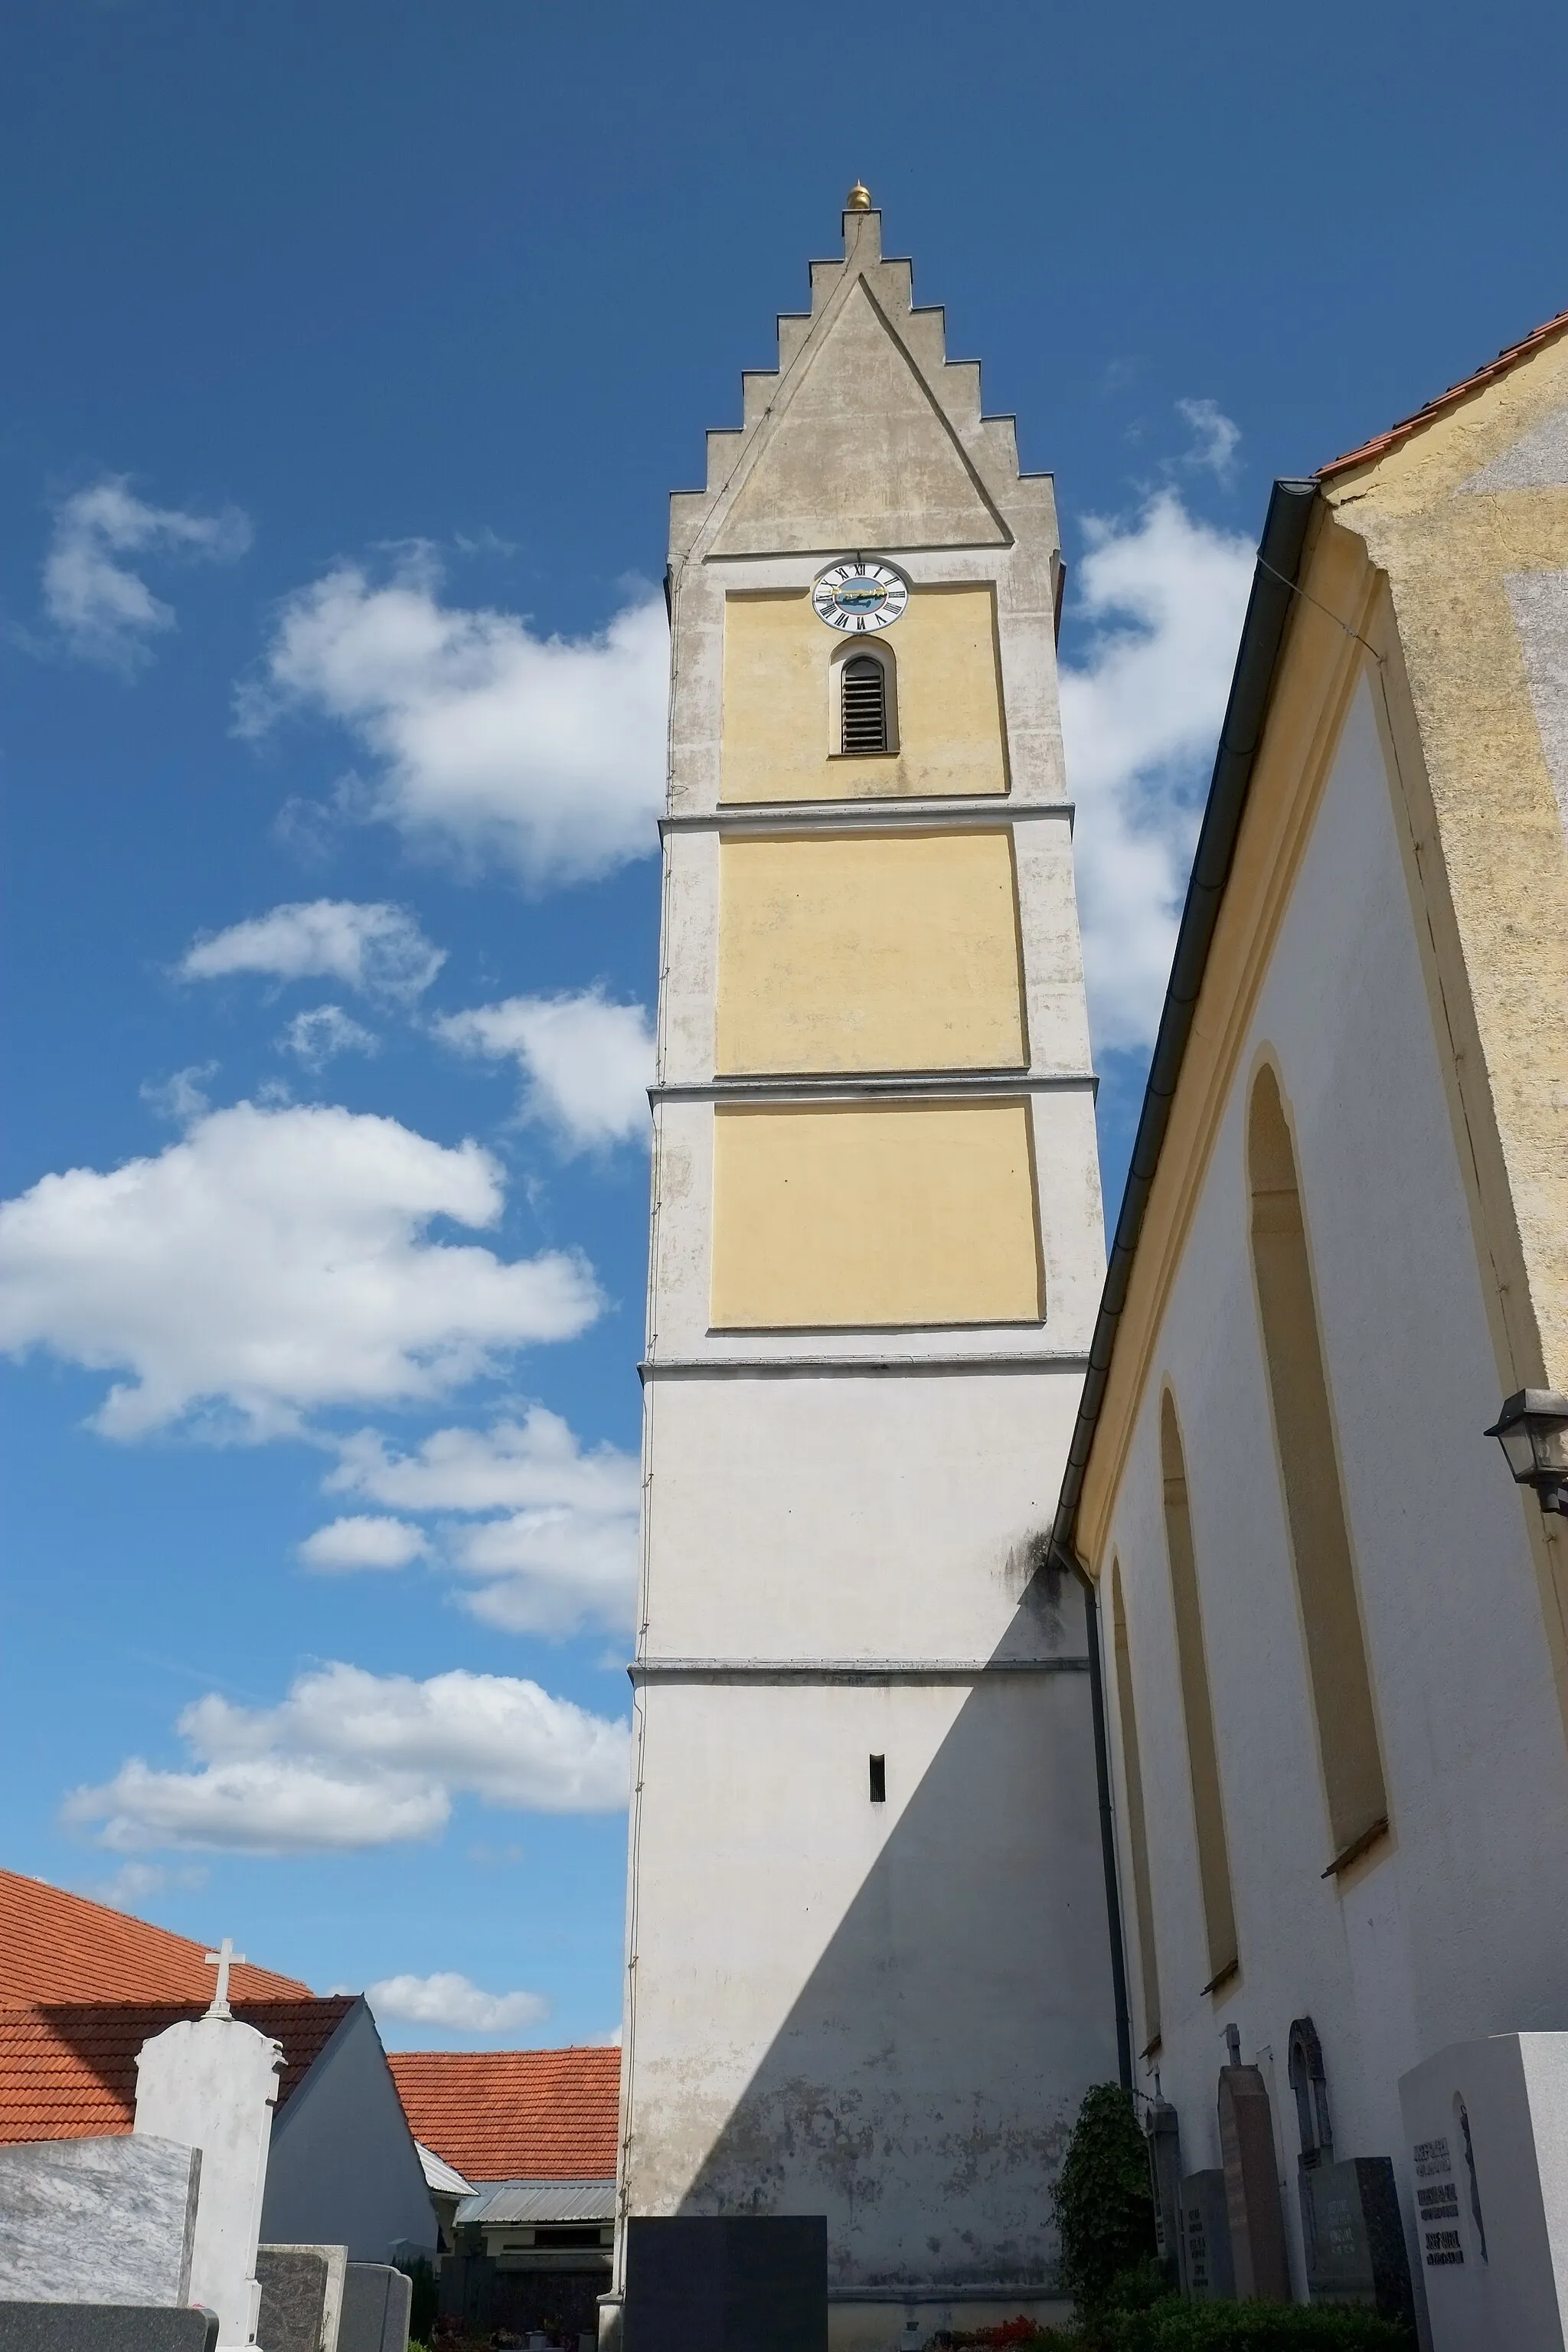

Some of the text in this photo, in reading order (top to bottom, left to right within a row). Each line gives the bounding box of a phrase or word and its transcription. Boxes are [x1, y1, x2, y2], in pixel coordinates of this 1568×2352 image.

[835, 567, 850, 580] XI
[854, 564, 866, 576] XII
[821, 579, 838, 588] X
[884, 577, 900, 586] II
[820, 604, 838, 619] VIII
[834, 613, 850, 628] VII
[857, 617, 866, 629] VI
[875, 613, 887, 626] V
